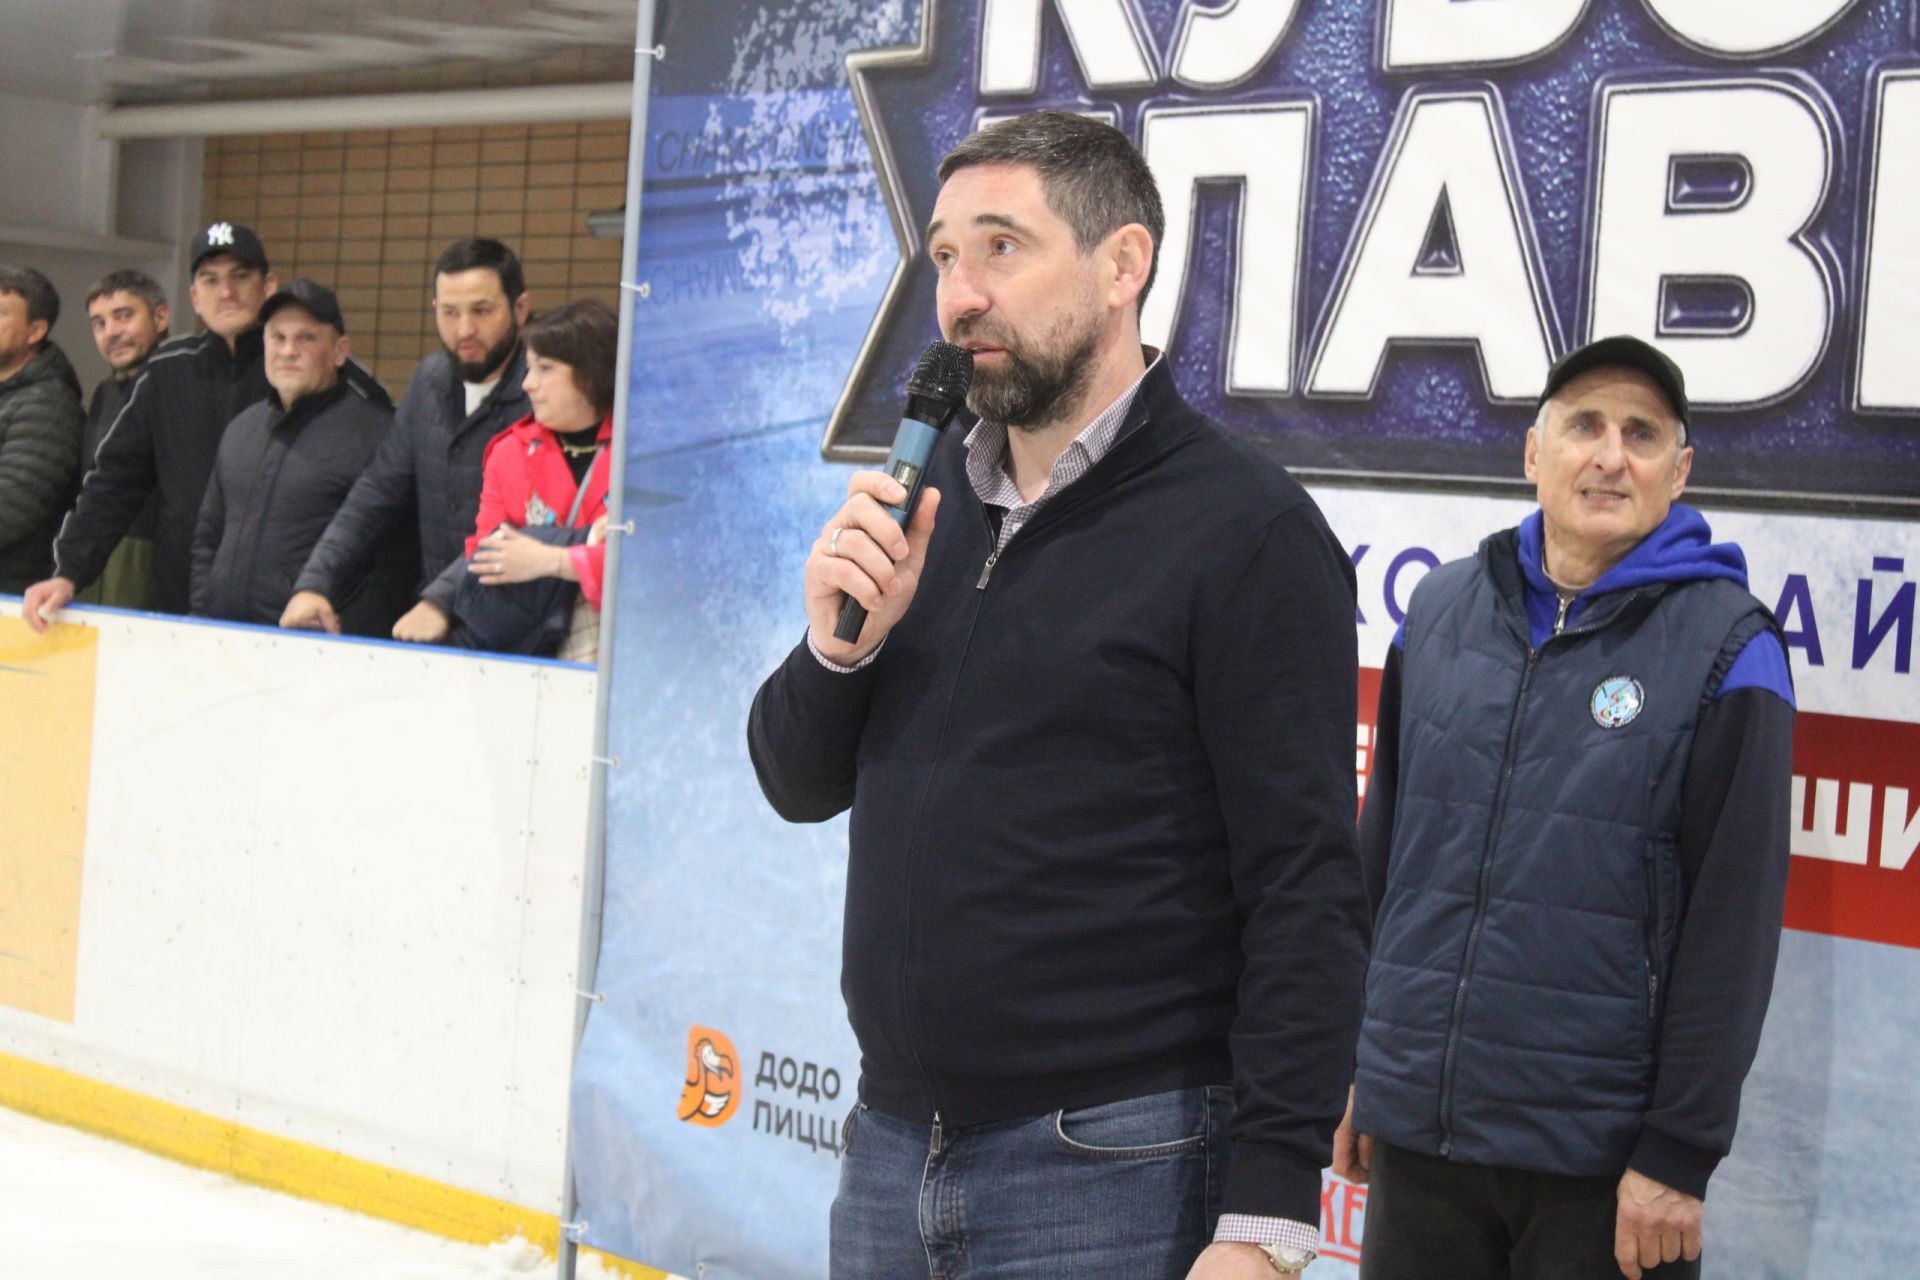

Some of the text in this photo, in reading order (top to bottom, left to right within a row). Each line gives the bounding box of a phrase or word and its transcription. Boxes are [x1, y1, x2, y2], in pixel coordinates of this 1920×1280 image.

[207, 222, 234, 246] NY
[976, 72, 1920, 412] ЛАВ
[755, 1051, 841, 1103] ДОДО
[753, 1099, 843, 1159] ПИЦЦ
